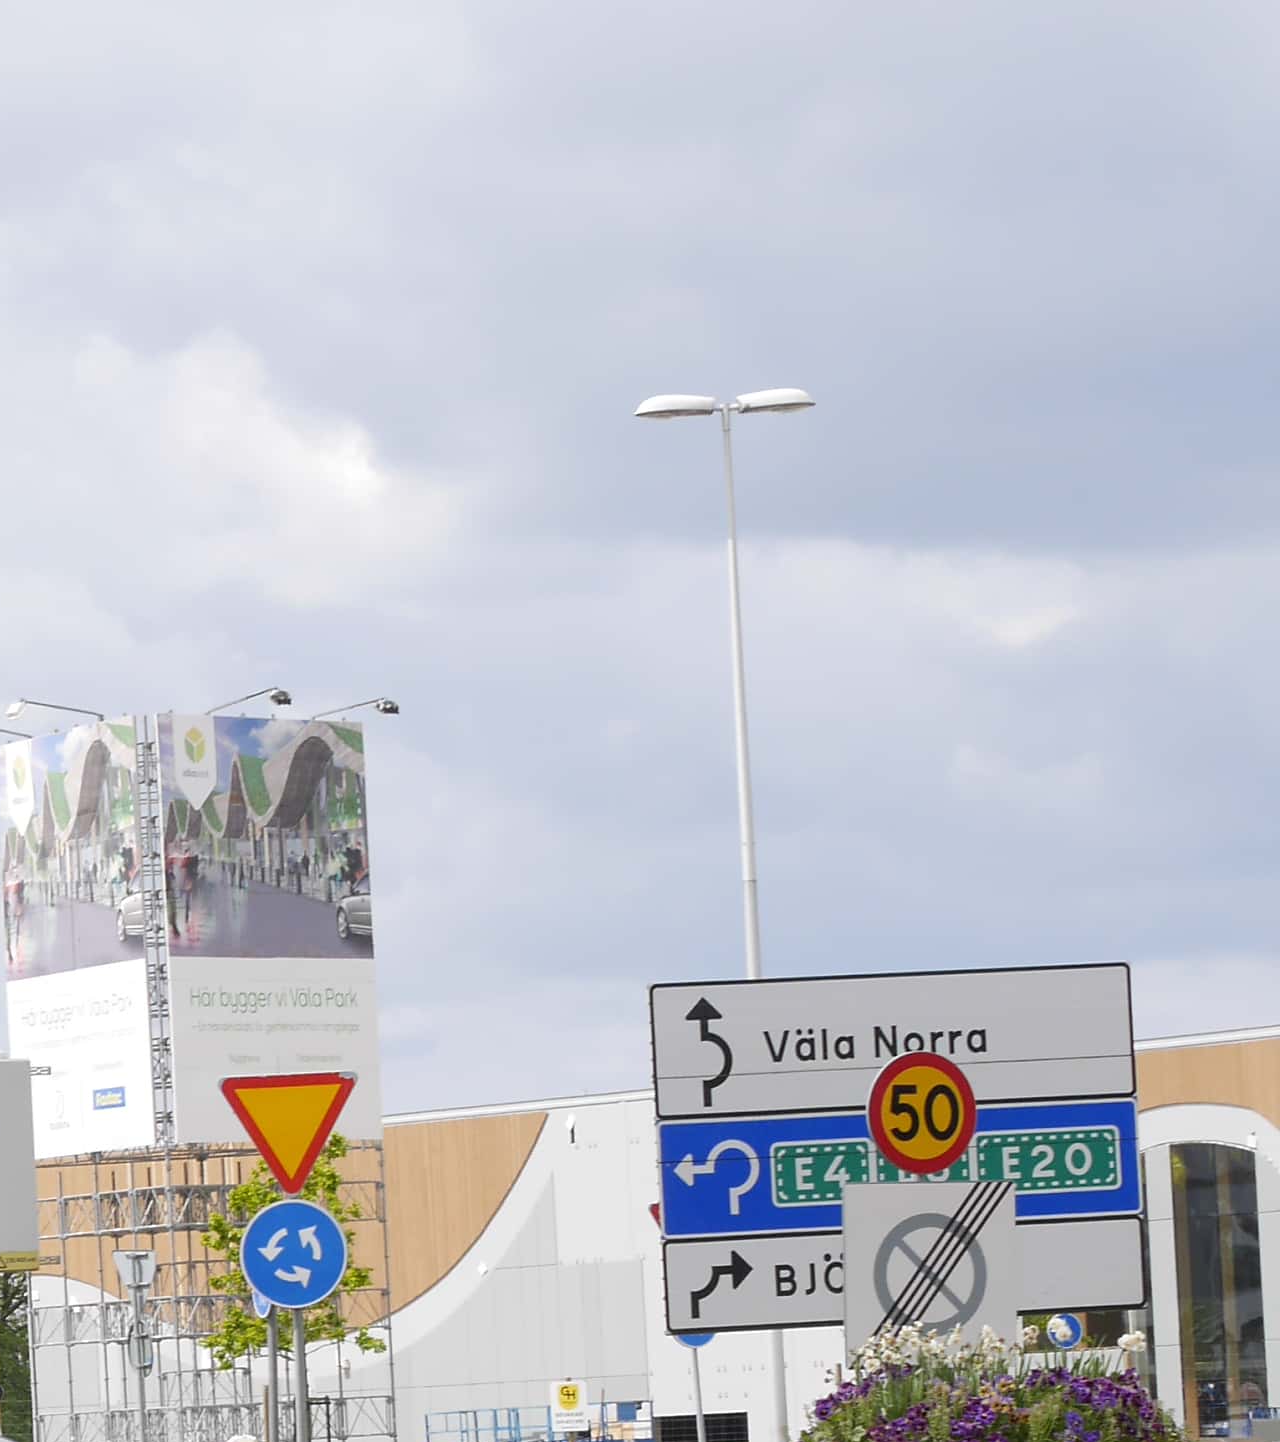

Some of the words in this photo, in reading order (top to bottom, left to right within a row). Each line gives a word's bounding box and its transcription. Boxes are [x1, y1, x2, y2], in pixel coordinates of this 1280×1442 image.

[219, 987, 272, 1013] bygger
[763, 1028, 856, 1063] Väla
[874, 1026, 988, 1058] Norra
[889, 1084, 960, 1142] 50
[794, 1154, 851, 1191] E4
[1001, 1143, 1093, 1180] E20
